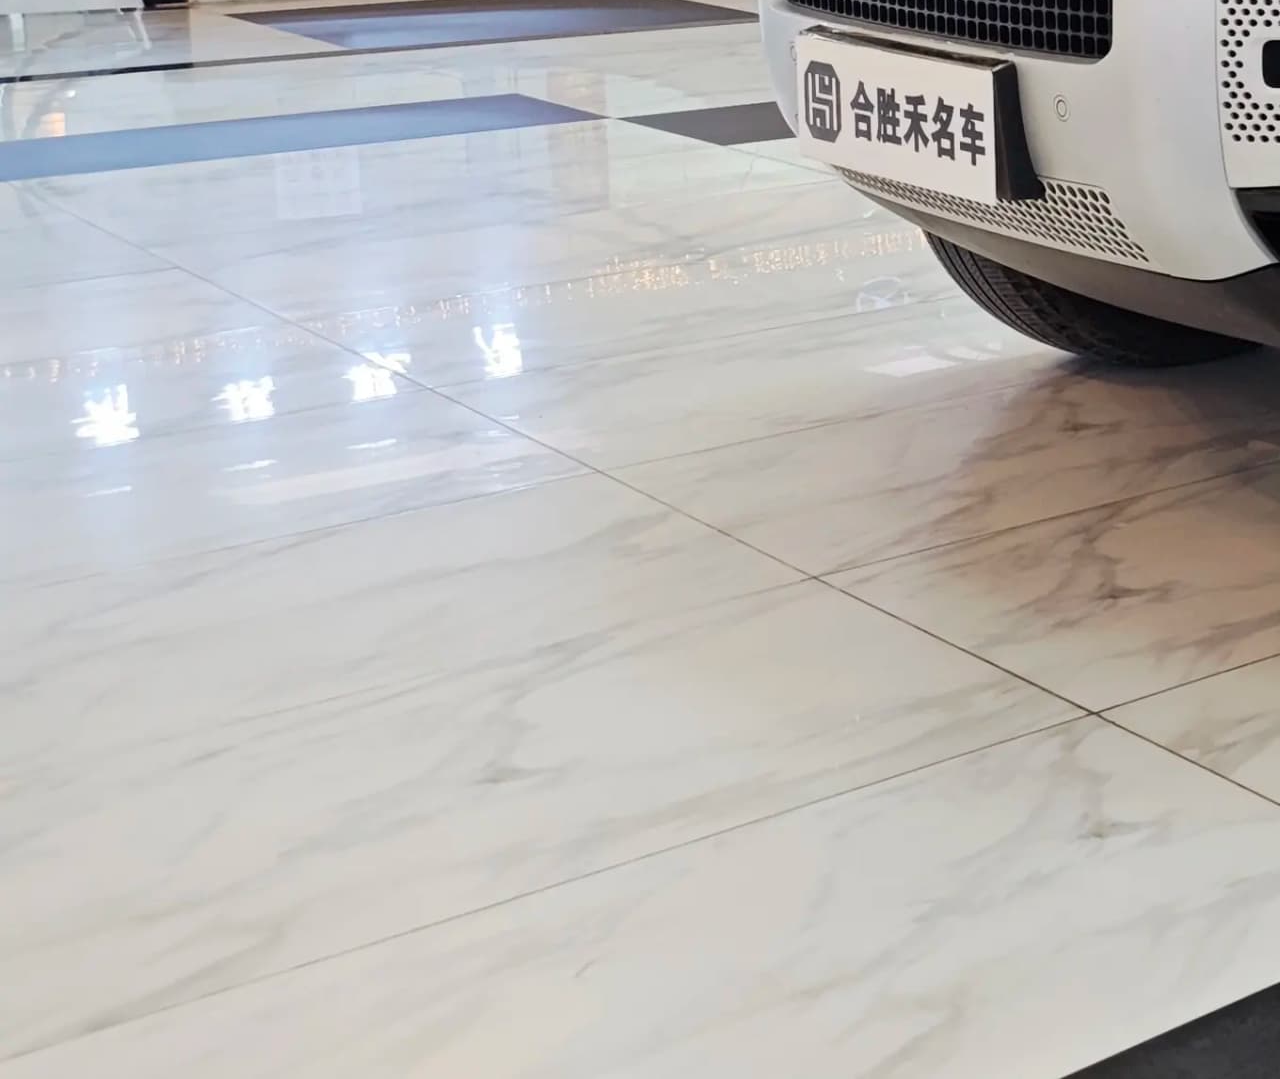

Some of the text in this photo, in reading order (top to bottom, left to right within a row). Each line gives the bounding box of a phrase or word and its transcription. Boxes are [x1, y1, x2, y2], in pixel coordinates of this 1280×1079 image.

[850, 80, 986, 166] 合胜禾名车
